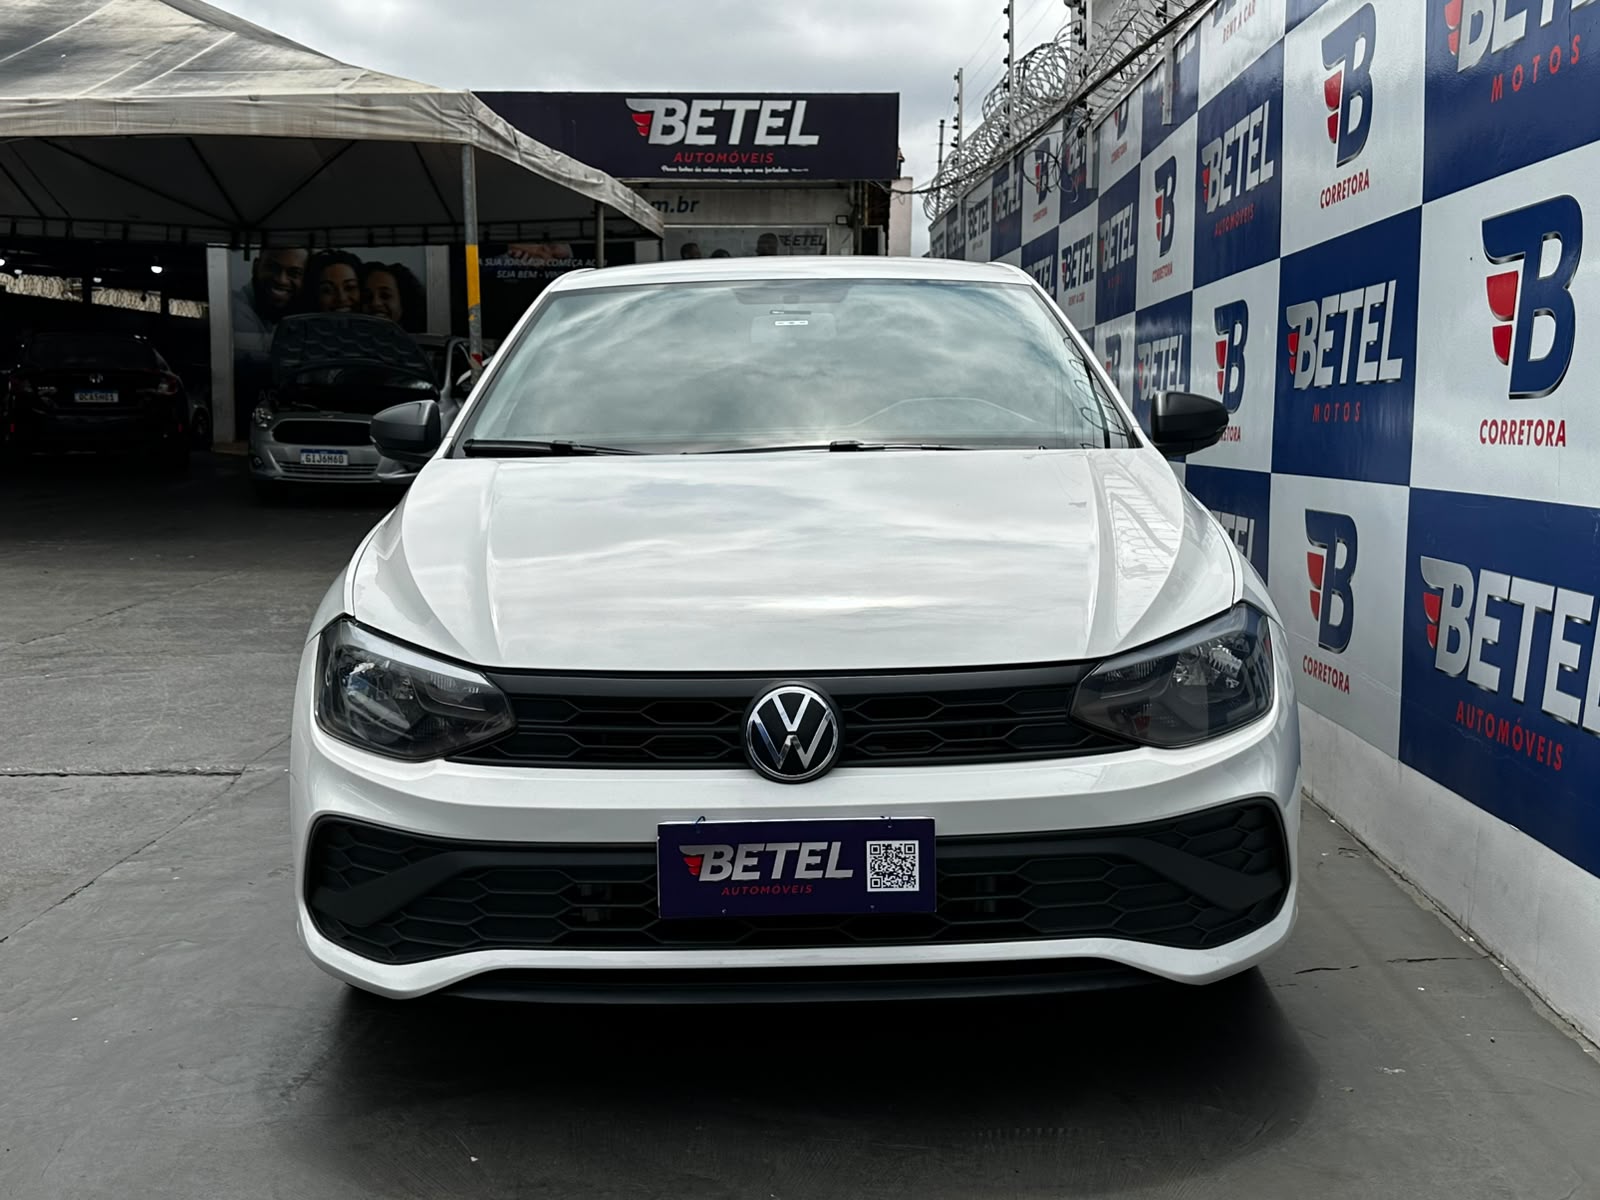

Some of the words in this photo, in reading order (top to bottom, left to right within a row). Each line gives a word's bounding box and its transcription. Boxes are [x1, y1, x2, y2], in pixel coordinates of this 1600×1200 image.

[1491, 34, 1581, 103] MOTOS
[626, 97, 820, 147] BETEL
[673, 150, 775, 164] AUTOMÓVEIS
[1201, 100, 1274, 214] BETEL
[1320, 168, 1370, 210] CORRETORA
[1100, 202, 1135, 272] BETEL
[485, 258, 501, 267] SUA
[496, 270, 516, 279] SEJA
[1061, 232, 1095, 292] BETEL
[1286, 279, 1403, 390] BETEL
[1137, 334, 1185, 401] BETEL
[1312, 401, 1361, 423] MOTOS
[1479, 419, 1567, 447] CORRETORA
[1302, 654, 1351, 695] CORRETORA
[1455, 700, 1564, 771] AUTOMÓVEIS
[679, 841, 854, 882] BETEL
[721, 884, 813, 896] AUTOMÓVEIS
